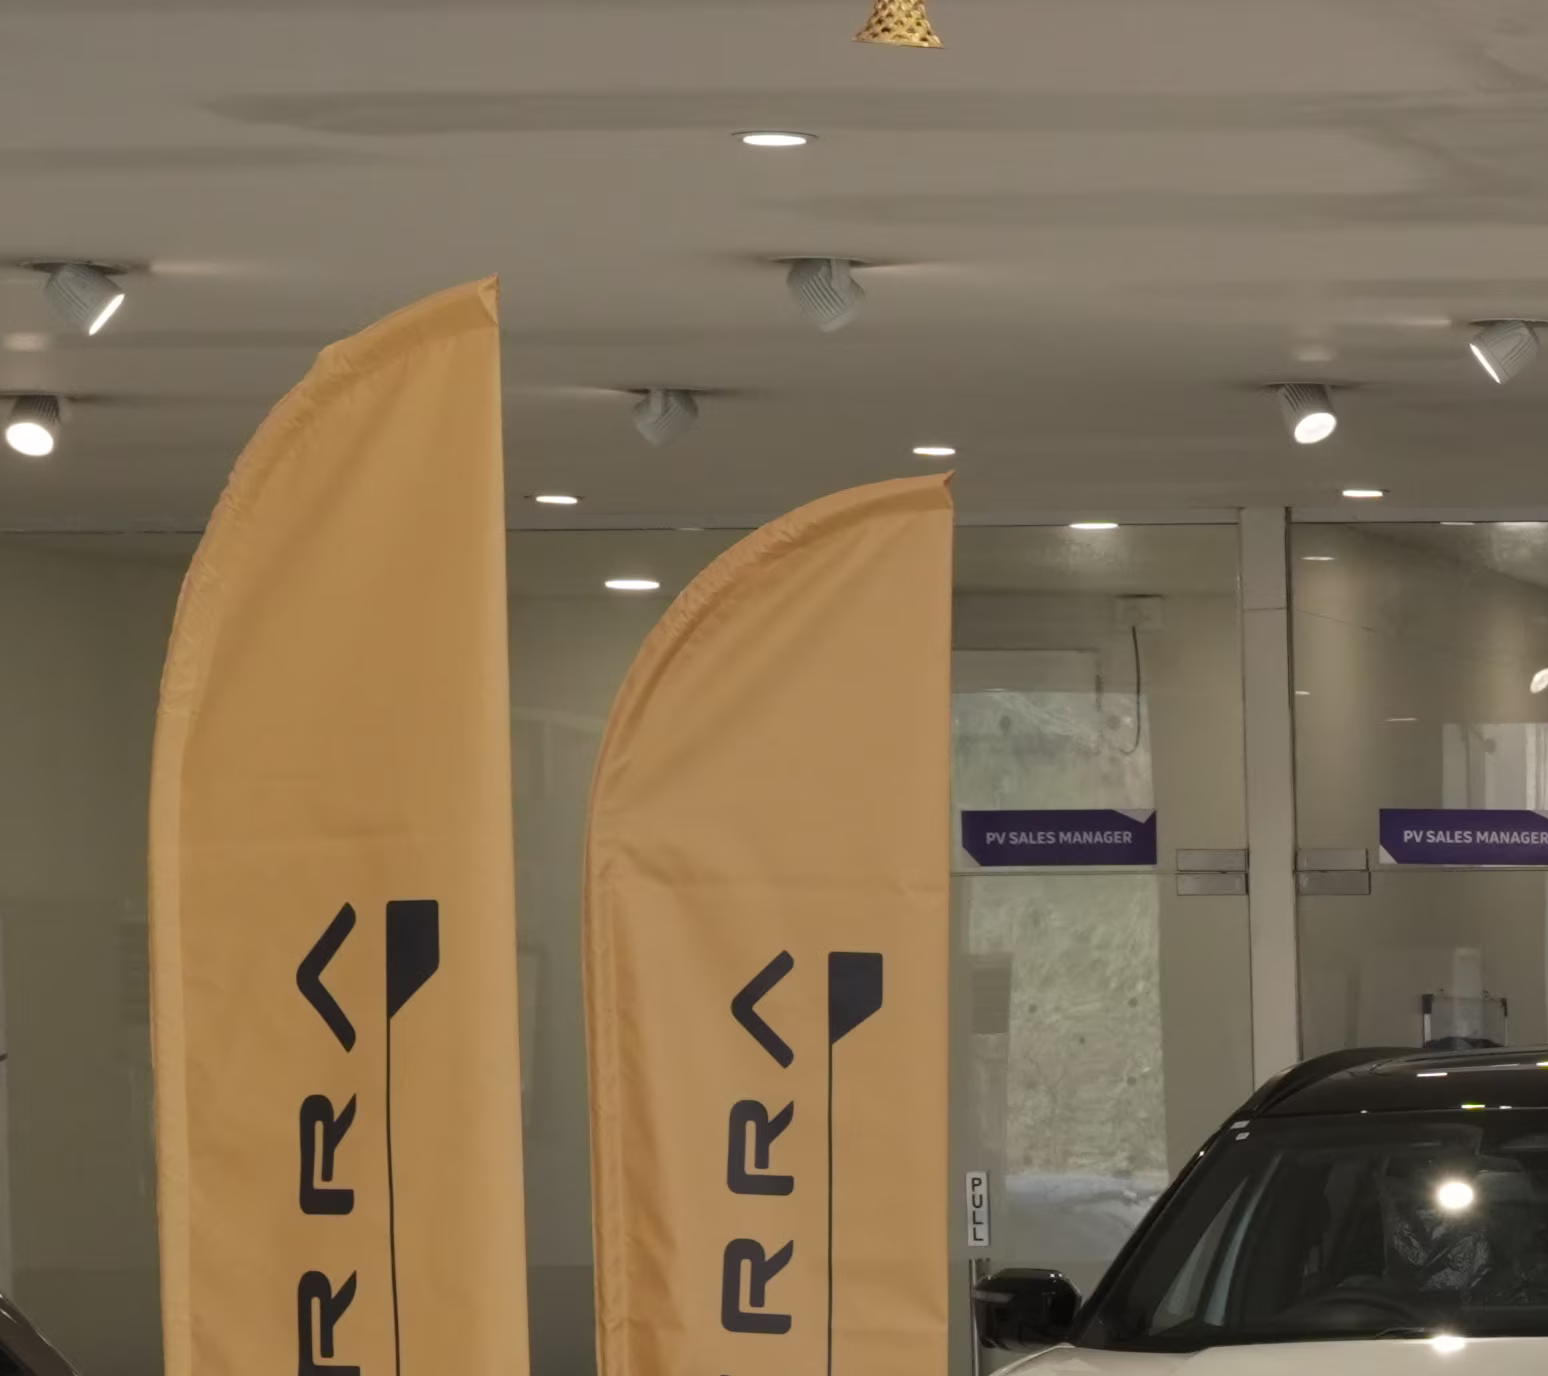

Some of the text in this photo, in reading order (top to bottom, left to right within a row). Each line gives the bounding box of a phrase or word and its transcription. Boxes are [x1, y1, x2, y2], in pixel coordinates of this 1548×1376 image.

[986, 831, 1132, 844] PV SALES MANAGER
[1403, 830, 1423, 843] PV
[1426, 830, 1473, 843] SALES
[971, 1177, 984, 1241] PULL
